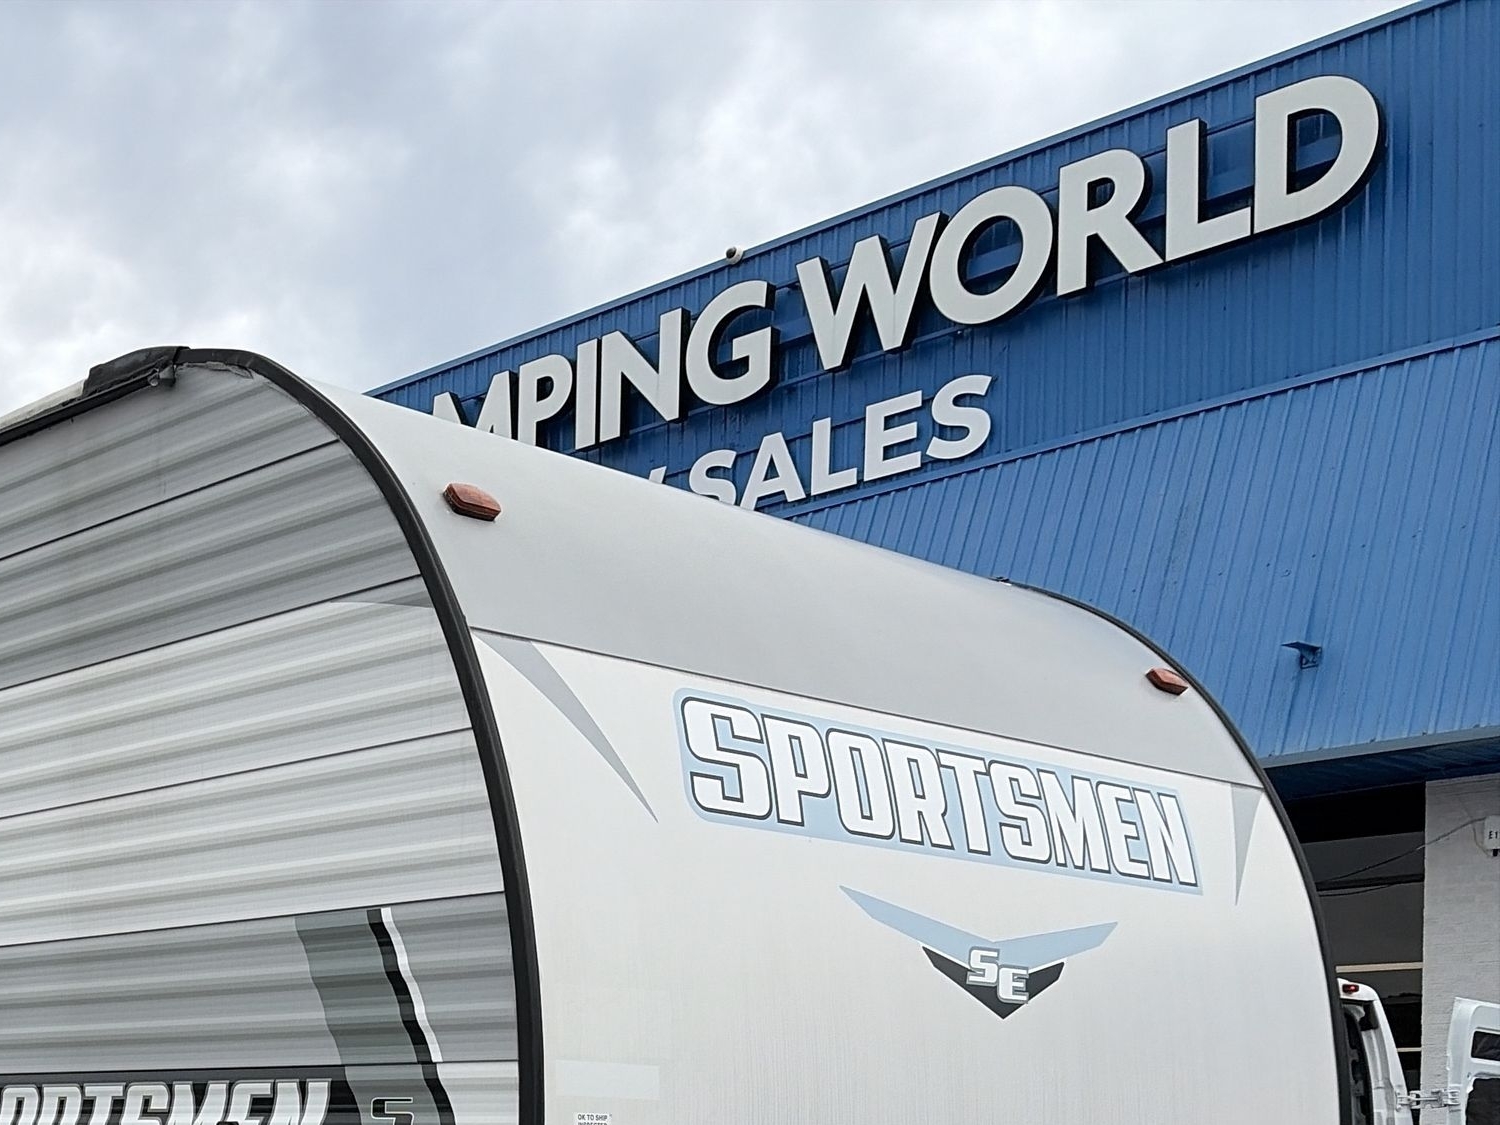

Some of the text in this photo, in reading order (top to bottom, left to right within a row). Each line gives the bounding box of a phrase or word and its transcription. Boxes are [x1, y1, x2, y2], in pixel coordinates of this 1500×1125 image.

[796, 74, 1380, 371] WORLD
[688, 374, 993, 511] SALES
[681, 696, 1198, 887] SPORTSMEN
[966, 946, 1029, 1004] SE
[577, 1113, 586, 1121] OK
